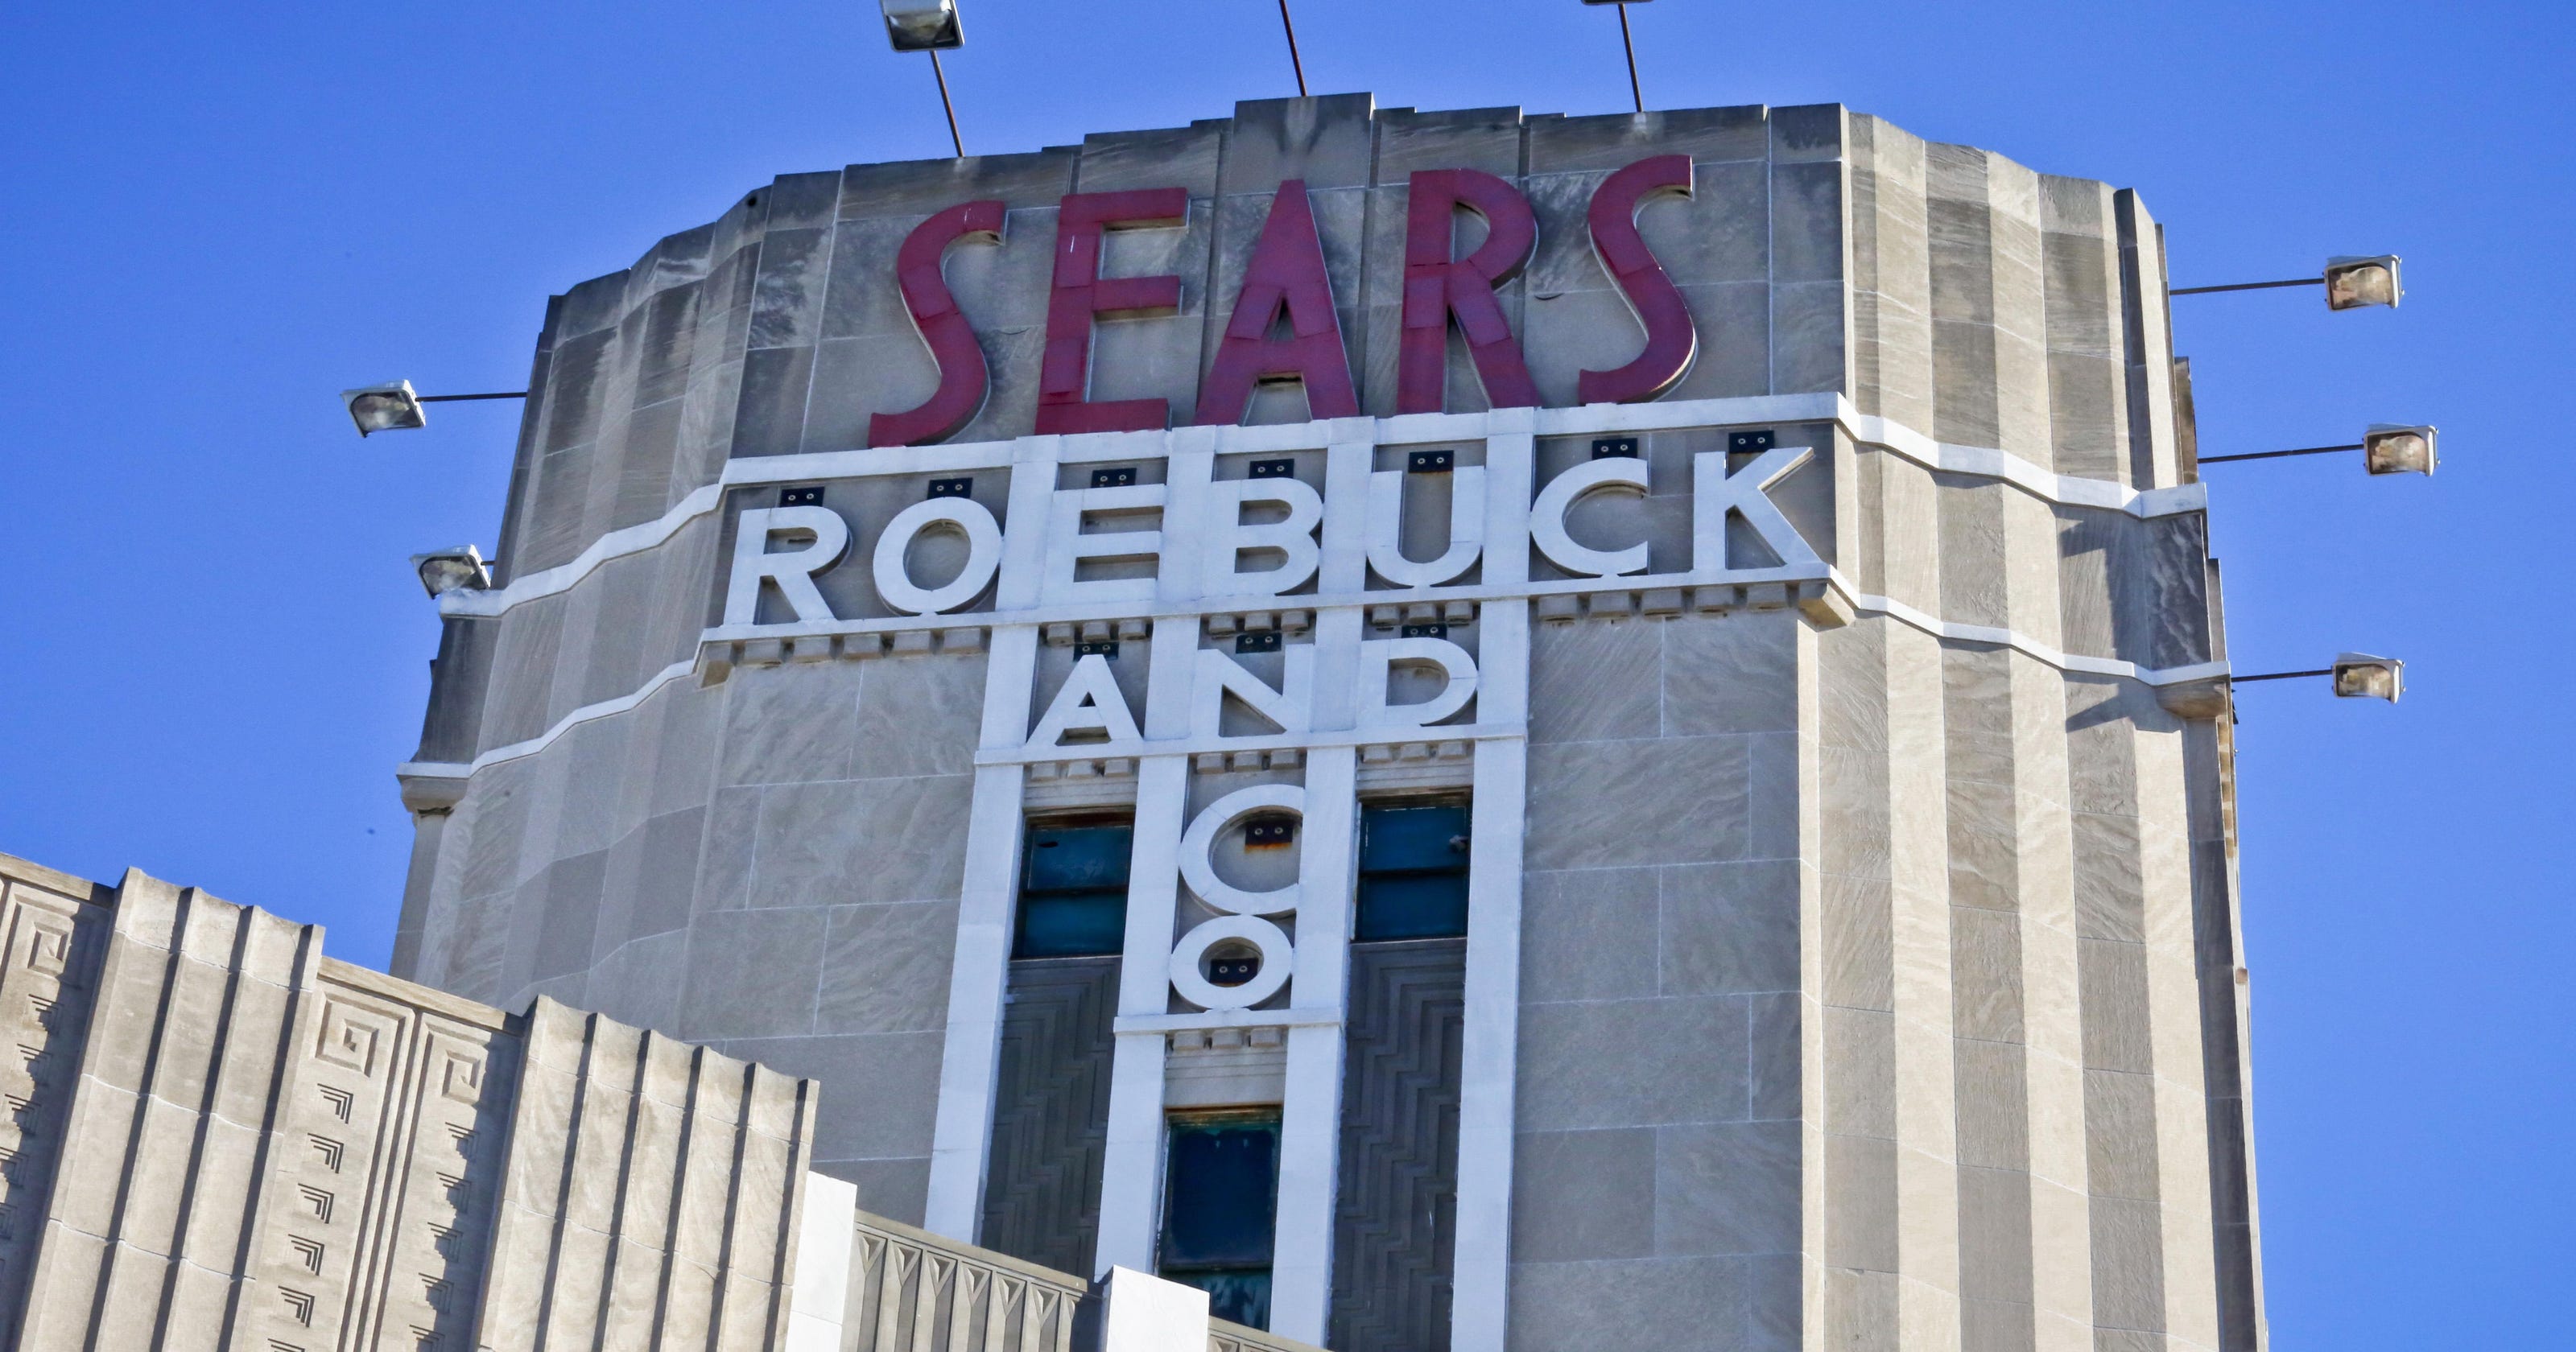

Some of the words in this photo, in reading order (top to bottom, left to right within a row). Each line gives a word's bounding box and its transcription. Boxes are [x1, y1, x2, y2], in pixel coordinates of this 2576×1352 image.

[869, 154, 1697, 447] SEARS
[724, 446, 1828, 626] ROEBUCK
[1026, 637, 1477, 746] AND
[1170, 784, 1305, 1010] CO
